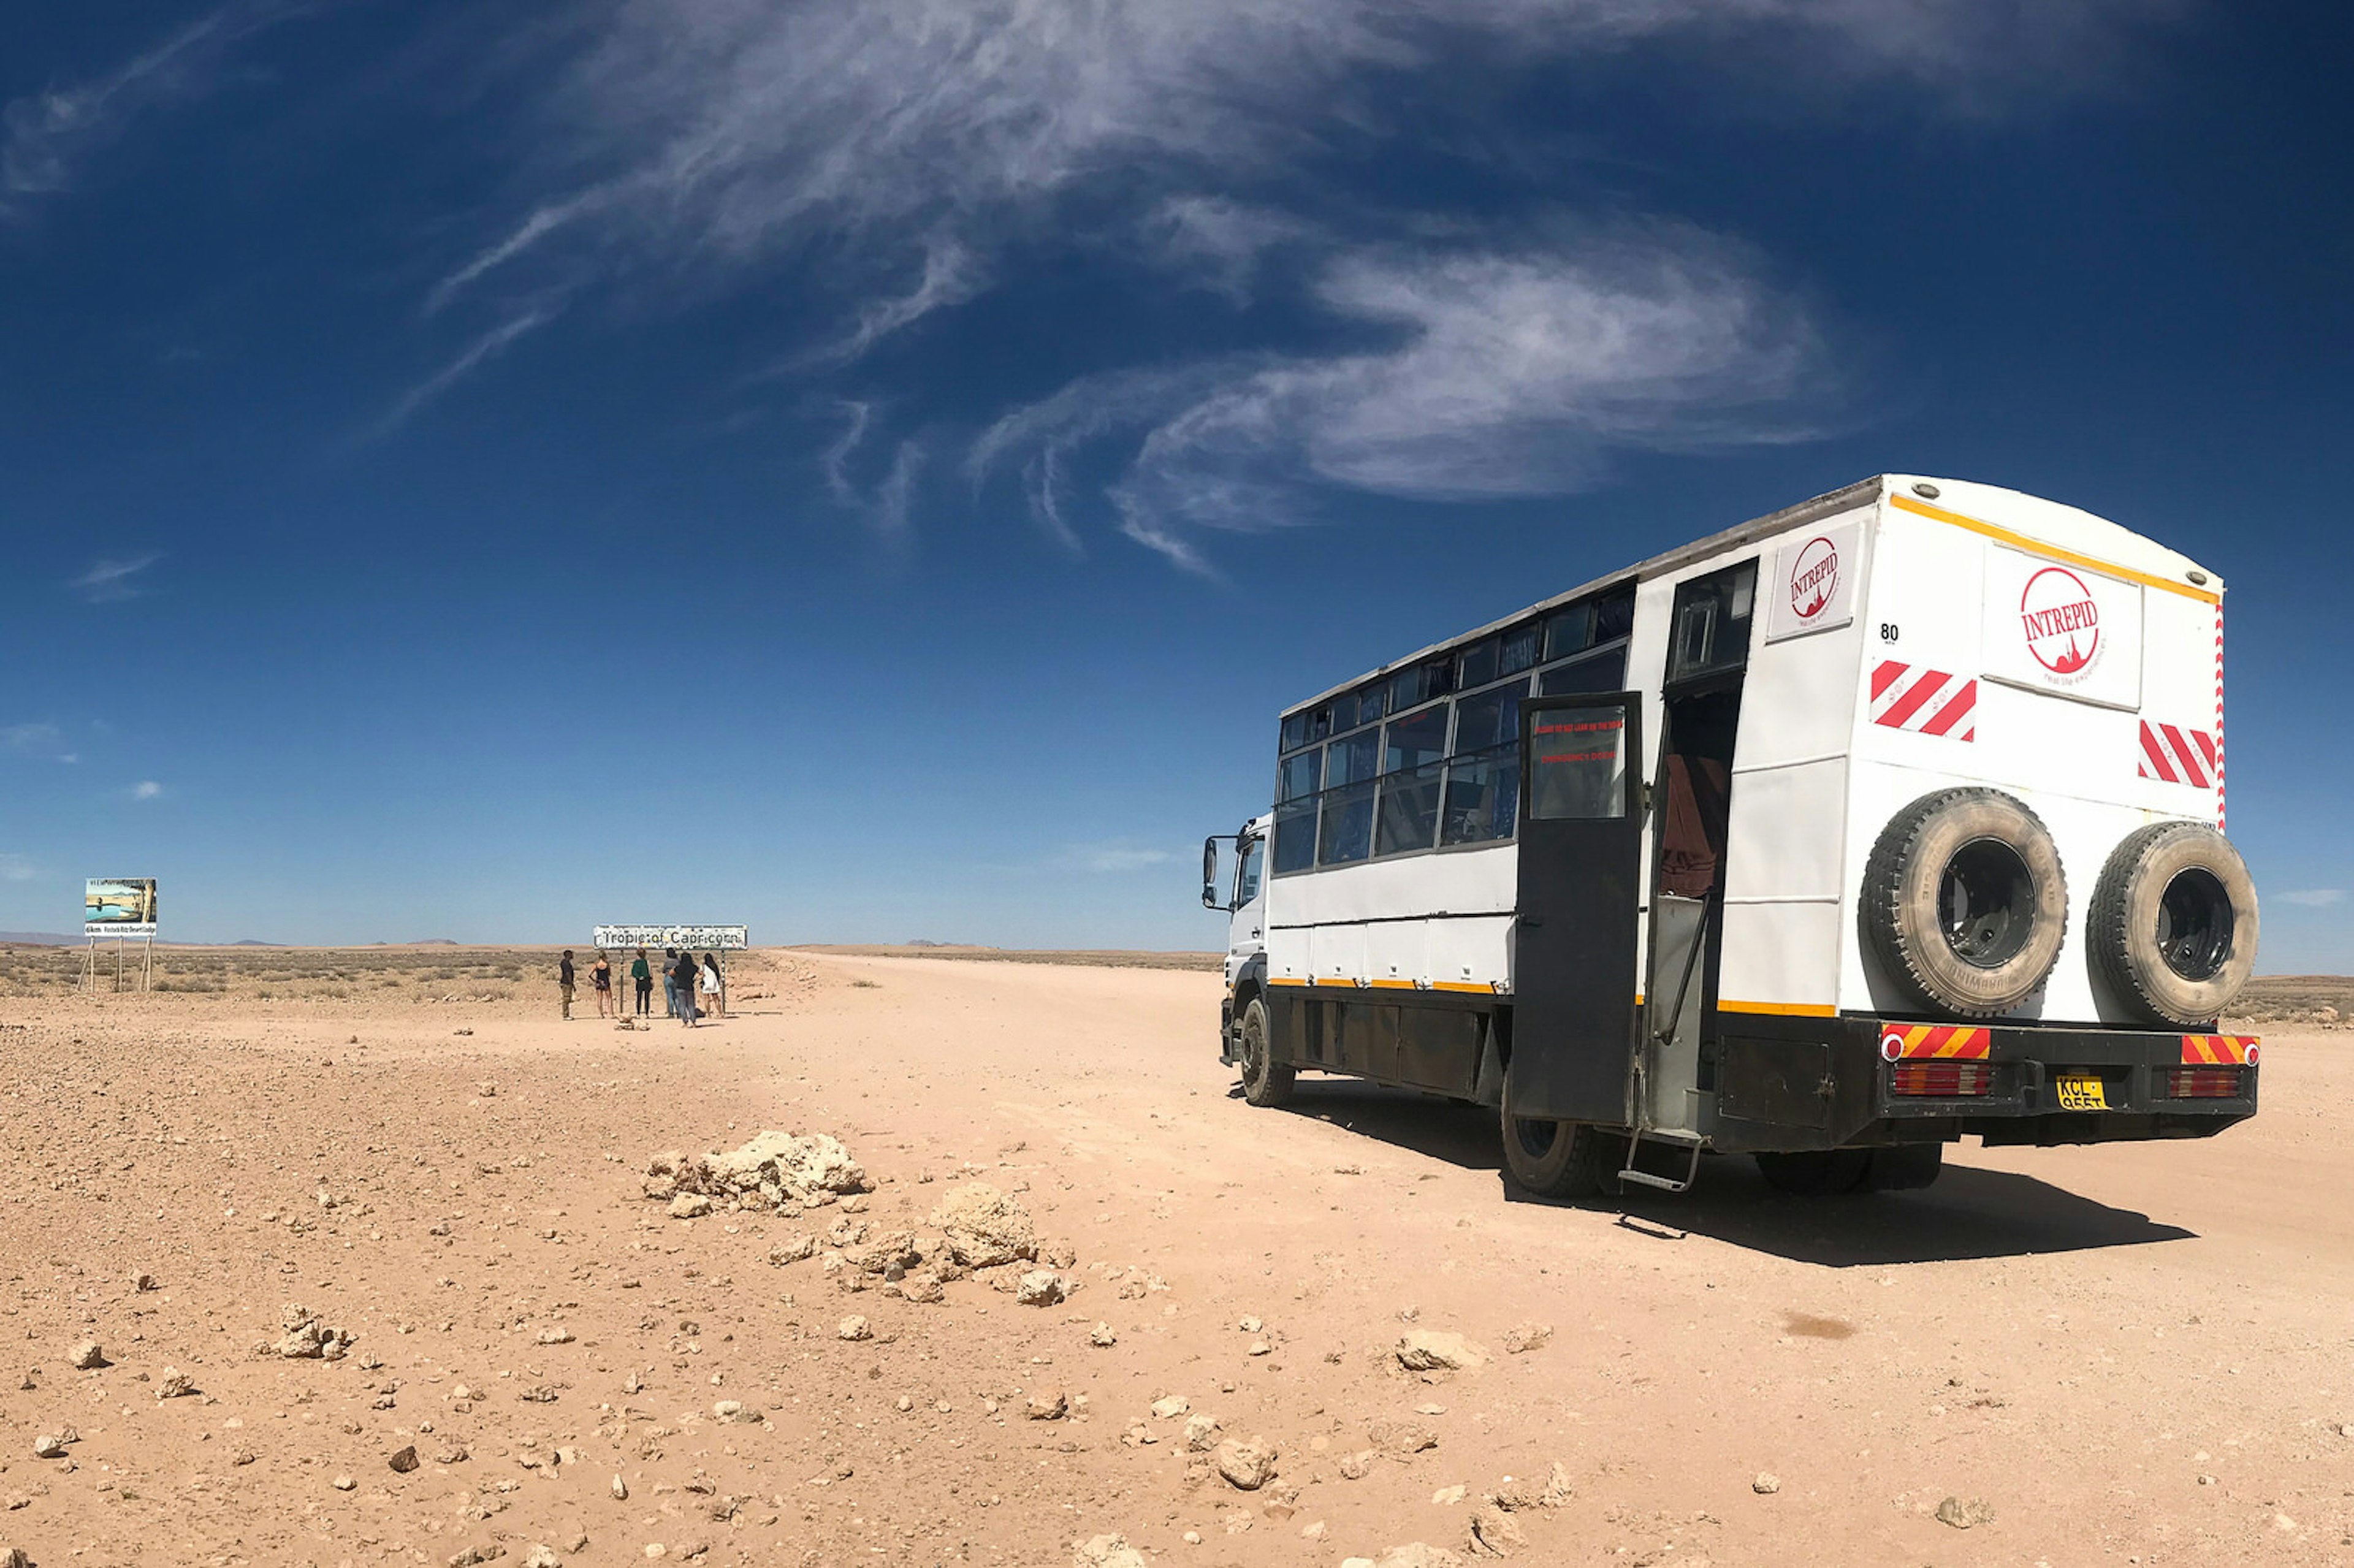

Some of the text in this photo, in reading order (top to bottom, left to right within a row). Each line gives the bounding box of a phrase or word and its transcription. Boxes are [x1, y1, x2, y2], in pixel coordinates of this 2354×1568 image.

[1791, 553, 1838, 601] INTREPID
[2021, 600, 2098, 641] INTREPID
[1881, 623, 1899, 641] 80
[1591, 751, 1615, 761] DOOR
[603, 931, 738, 946] Tropic of Capricorn
[2060, 1078, 2091, 1096] KCL
